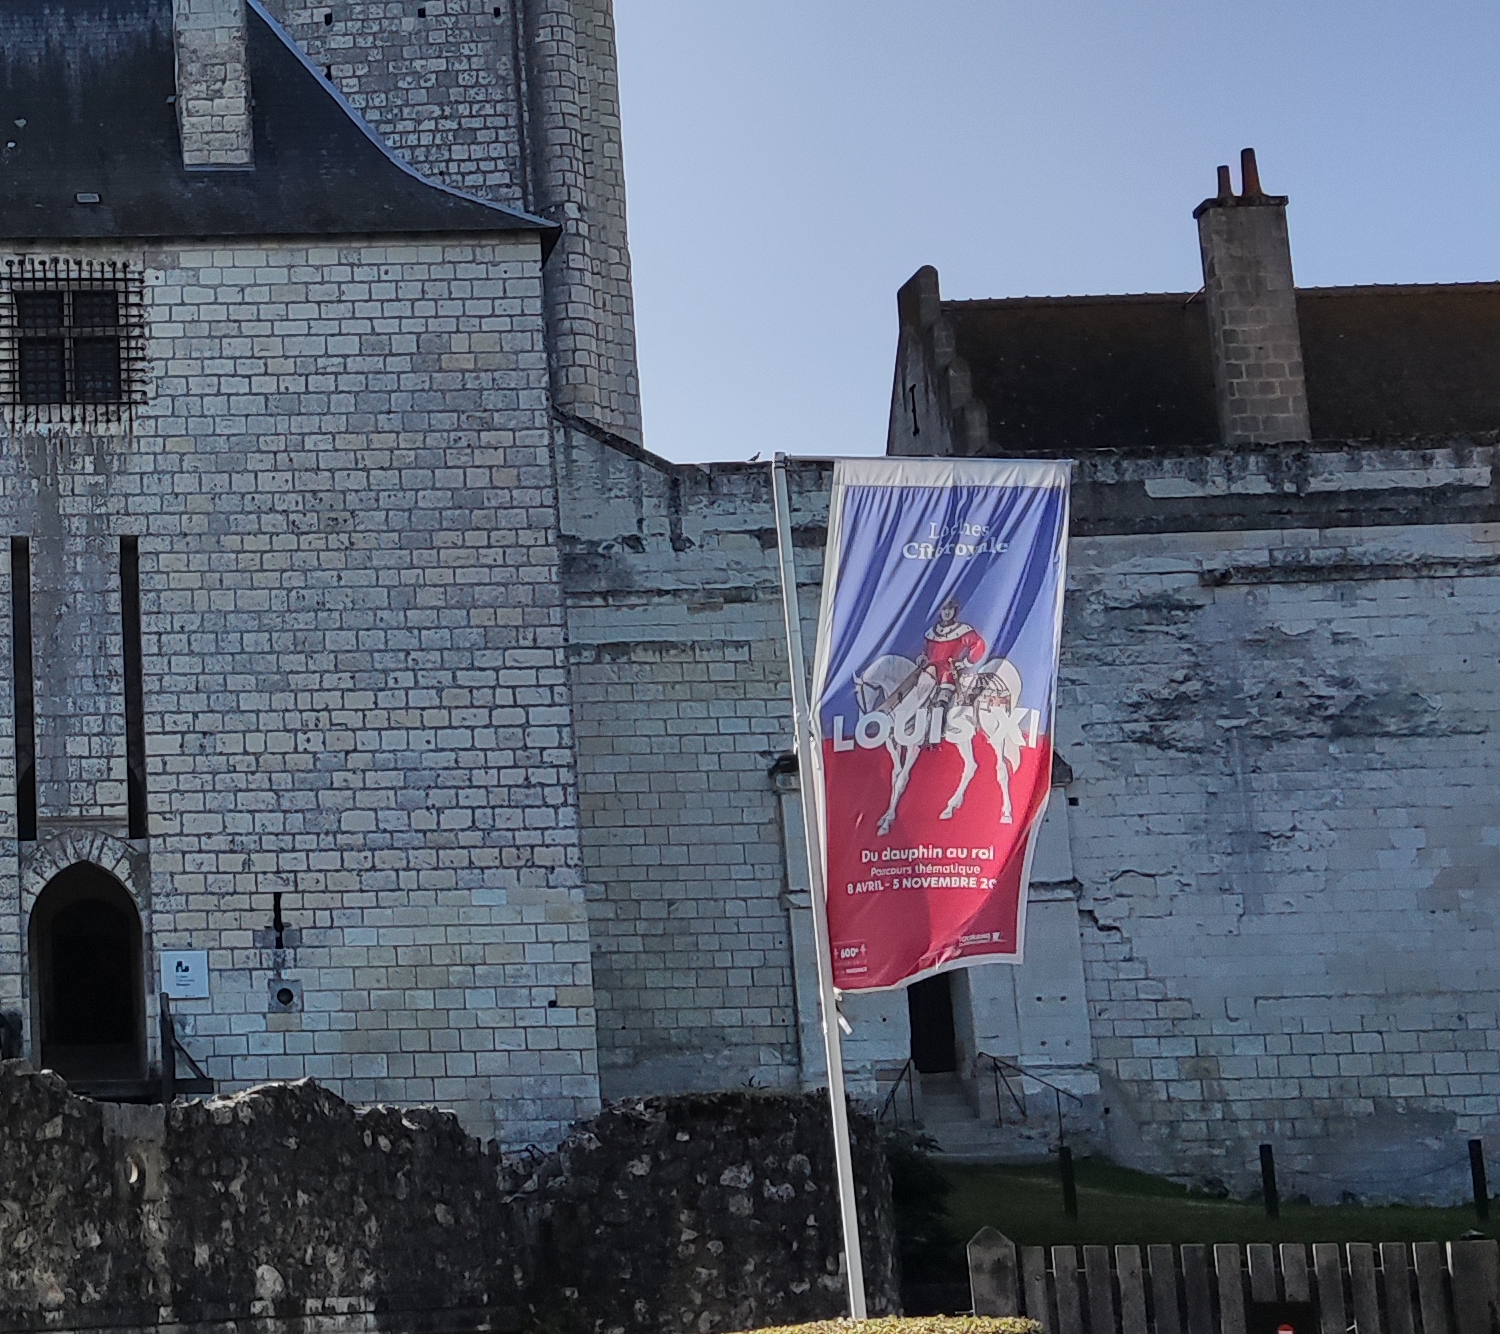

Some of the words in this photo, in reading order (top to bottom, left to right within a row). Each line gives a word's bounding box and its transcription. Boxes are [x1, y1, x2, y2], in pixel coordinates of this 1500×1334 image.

[833, 706, 975, 753] LOUIS
[990, 707, 1040, 749] XI
[861, 850, 878, 863] Du
[881, 844, 943, 862] dauphin
[946, 847, 968, 859] au
[971, 845, 994, 860] roi
[870, 865, 912, 877] Parcours
[915, 862, 981, 876] thématique
[847, 883, 854, 895] 8
[855, 879, 884, 894] AVRIL
[892, 878, 900, 890] 5
[902, 876, 978, 889] NOVEMBRE
[979, 877, 998, 890] 20
